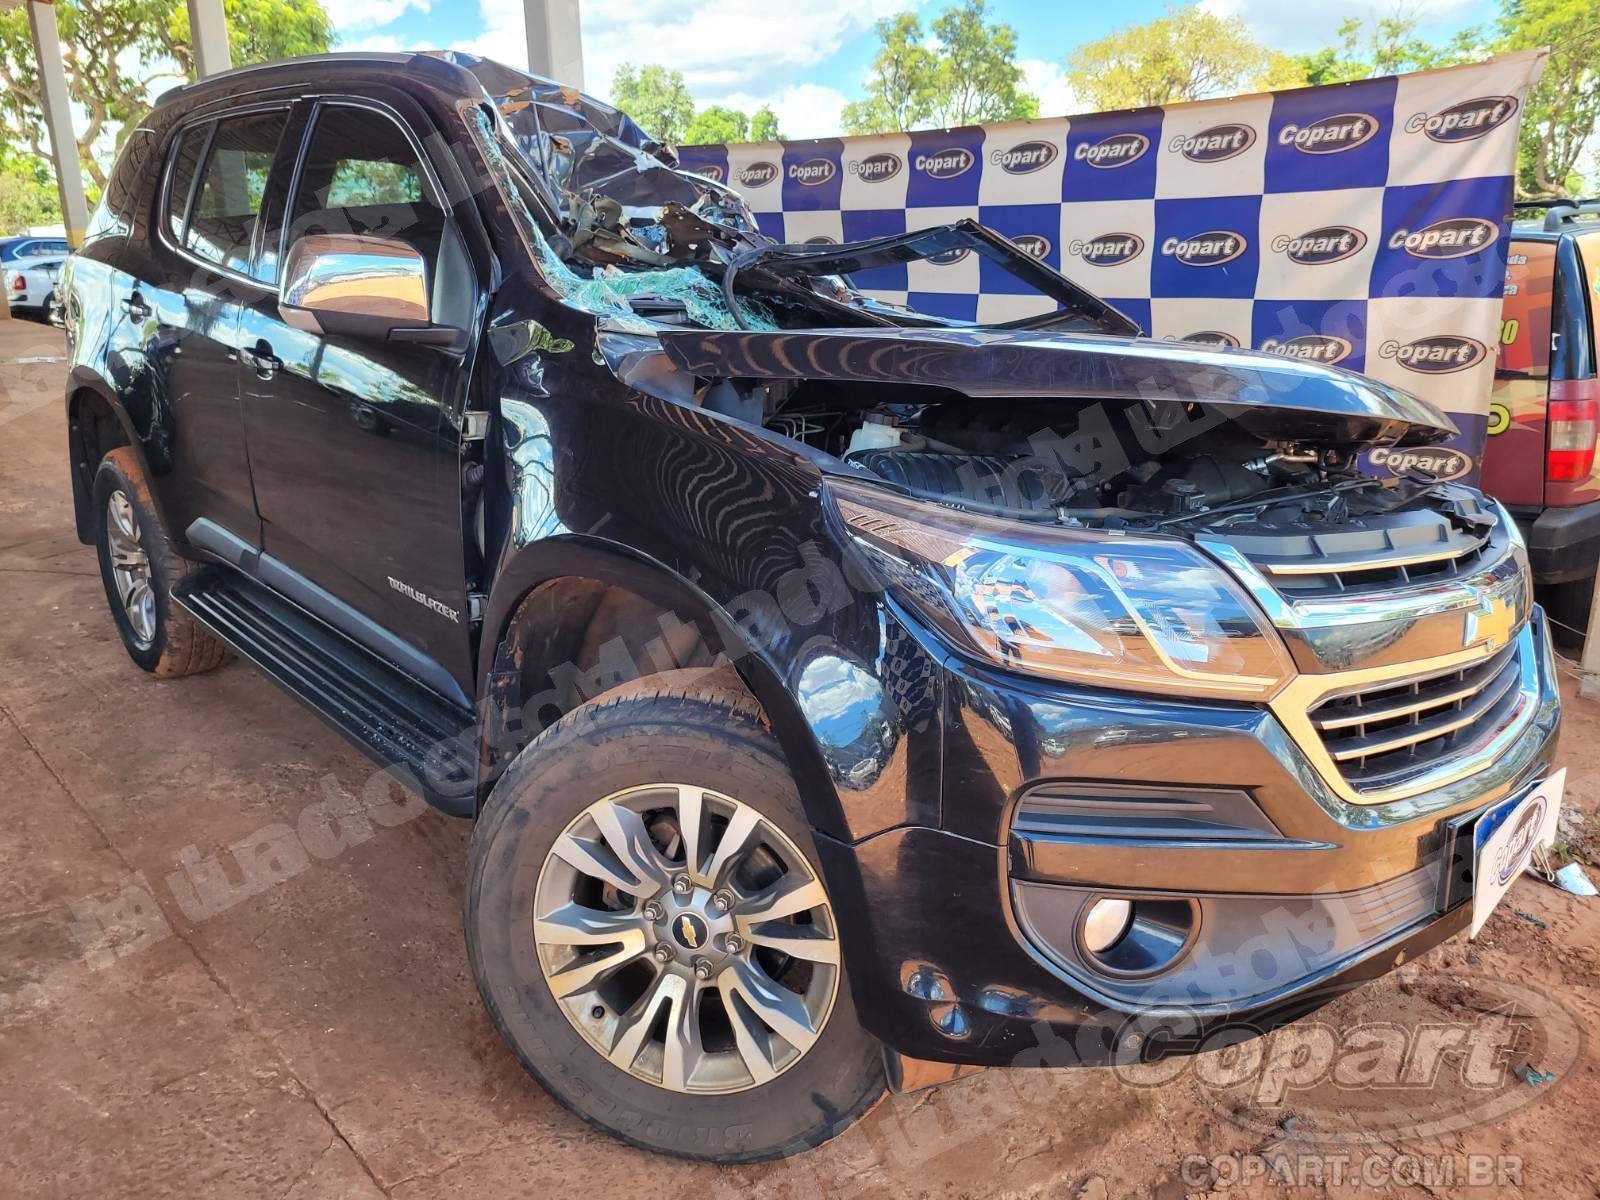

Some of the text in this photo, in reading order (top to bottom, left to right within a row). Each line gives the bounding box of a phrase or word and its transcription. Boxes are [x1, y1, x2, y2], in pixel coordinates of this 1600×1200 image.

[1404, 102, 1505, 135] Copart
[1168, 130, 1243, 153] Copart
[1278, 117, 1366, 148] Copart
[915, 152, 966, 172] Copart
[991, 146, 1048, 168] Copart
[1074, 139, 1141, 162] Copart
[734, 167, 772, 182] Copart
[789, 164, 830, 179] Copart
[849, 160, 894, 174] Copart
[1069, 235, 1135, 259] Copart
[1161, 236, 1236, 261] Copart
[1271, 232, 1353, 257] Copart
[1388, 224, 1487, 252] Copart
[1378, 339, 1470, 366] Copart
[1369, 447, 1459, 474] Copart
[387, 576, 459, 623] TRAILBLAZER
